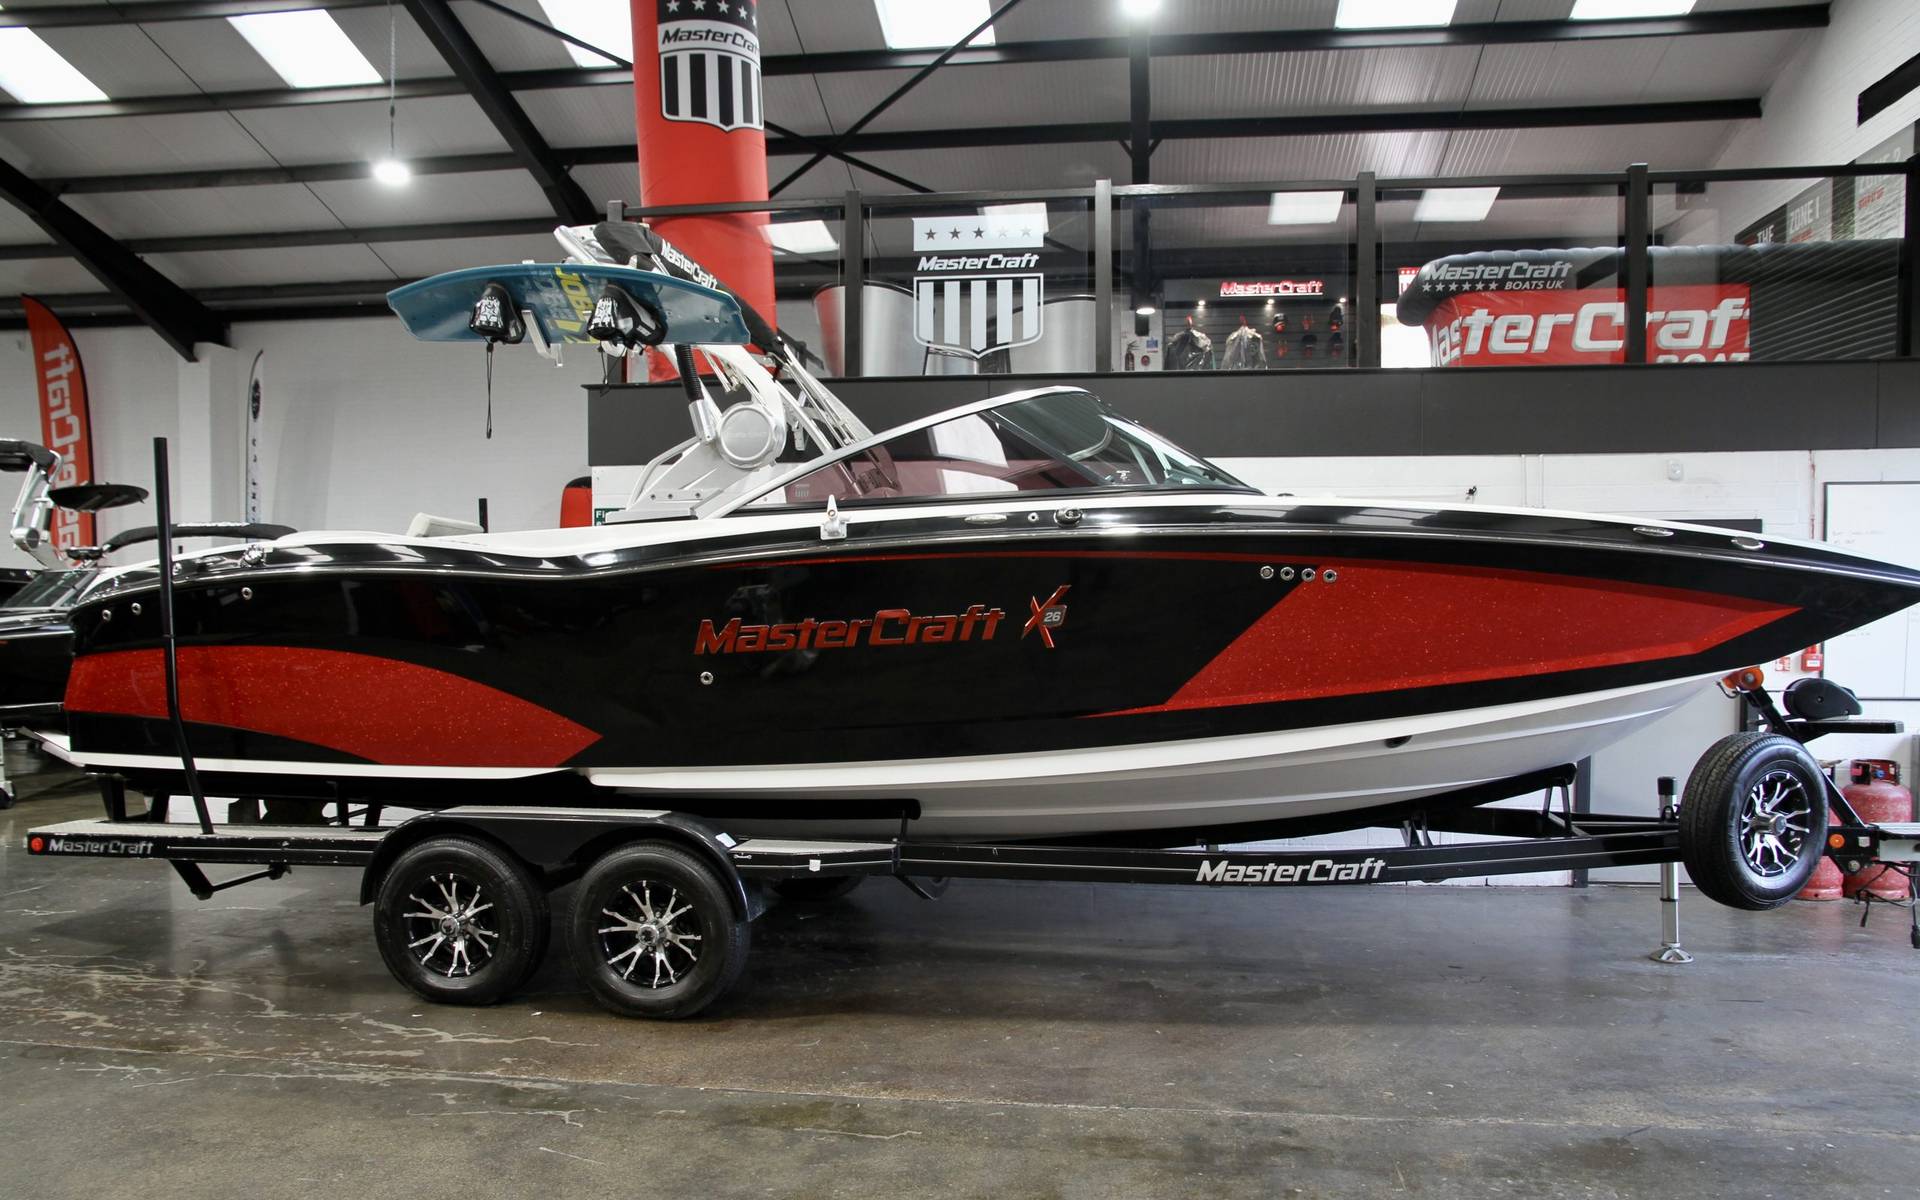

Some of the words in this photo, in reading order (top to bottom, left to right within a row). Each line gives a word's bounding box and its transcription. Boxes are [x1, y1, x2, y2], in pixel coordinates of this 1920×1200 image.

[662, 28, 758, 54] MasterCra
[1789, 200, 1813, 234] ZONE
[661, 238, 718, 290] MasterCraft
[917, 253, 1039, 271] MasterCraft
[1424, 261, 1572, 281] MasterCraft
[1220, 280, 1323, 296] MasterCraft
[1504, 281, 1543, 290] BOATS
[1546, 280, 1564, 289] UK
[694, 604, 1005, 655] MasterCraft
[48, 839, 154, 854] MasterCraft
[1196, 858, 1386, 882] MasterCraft
